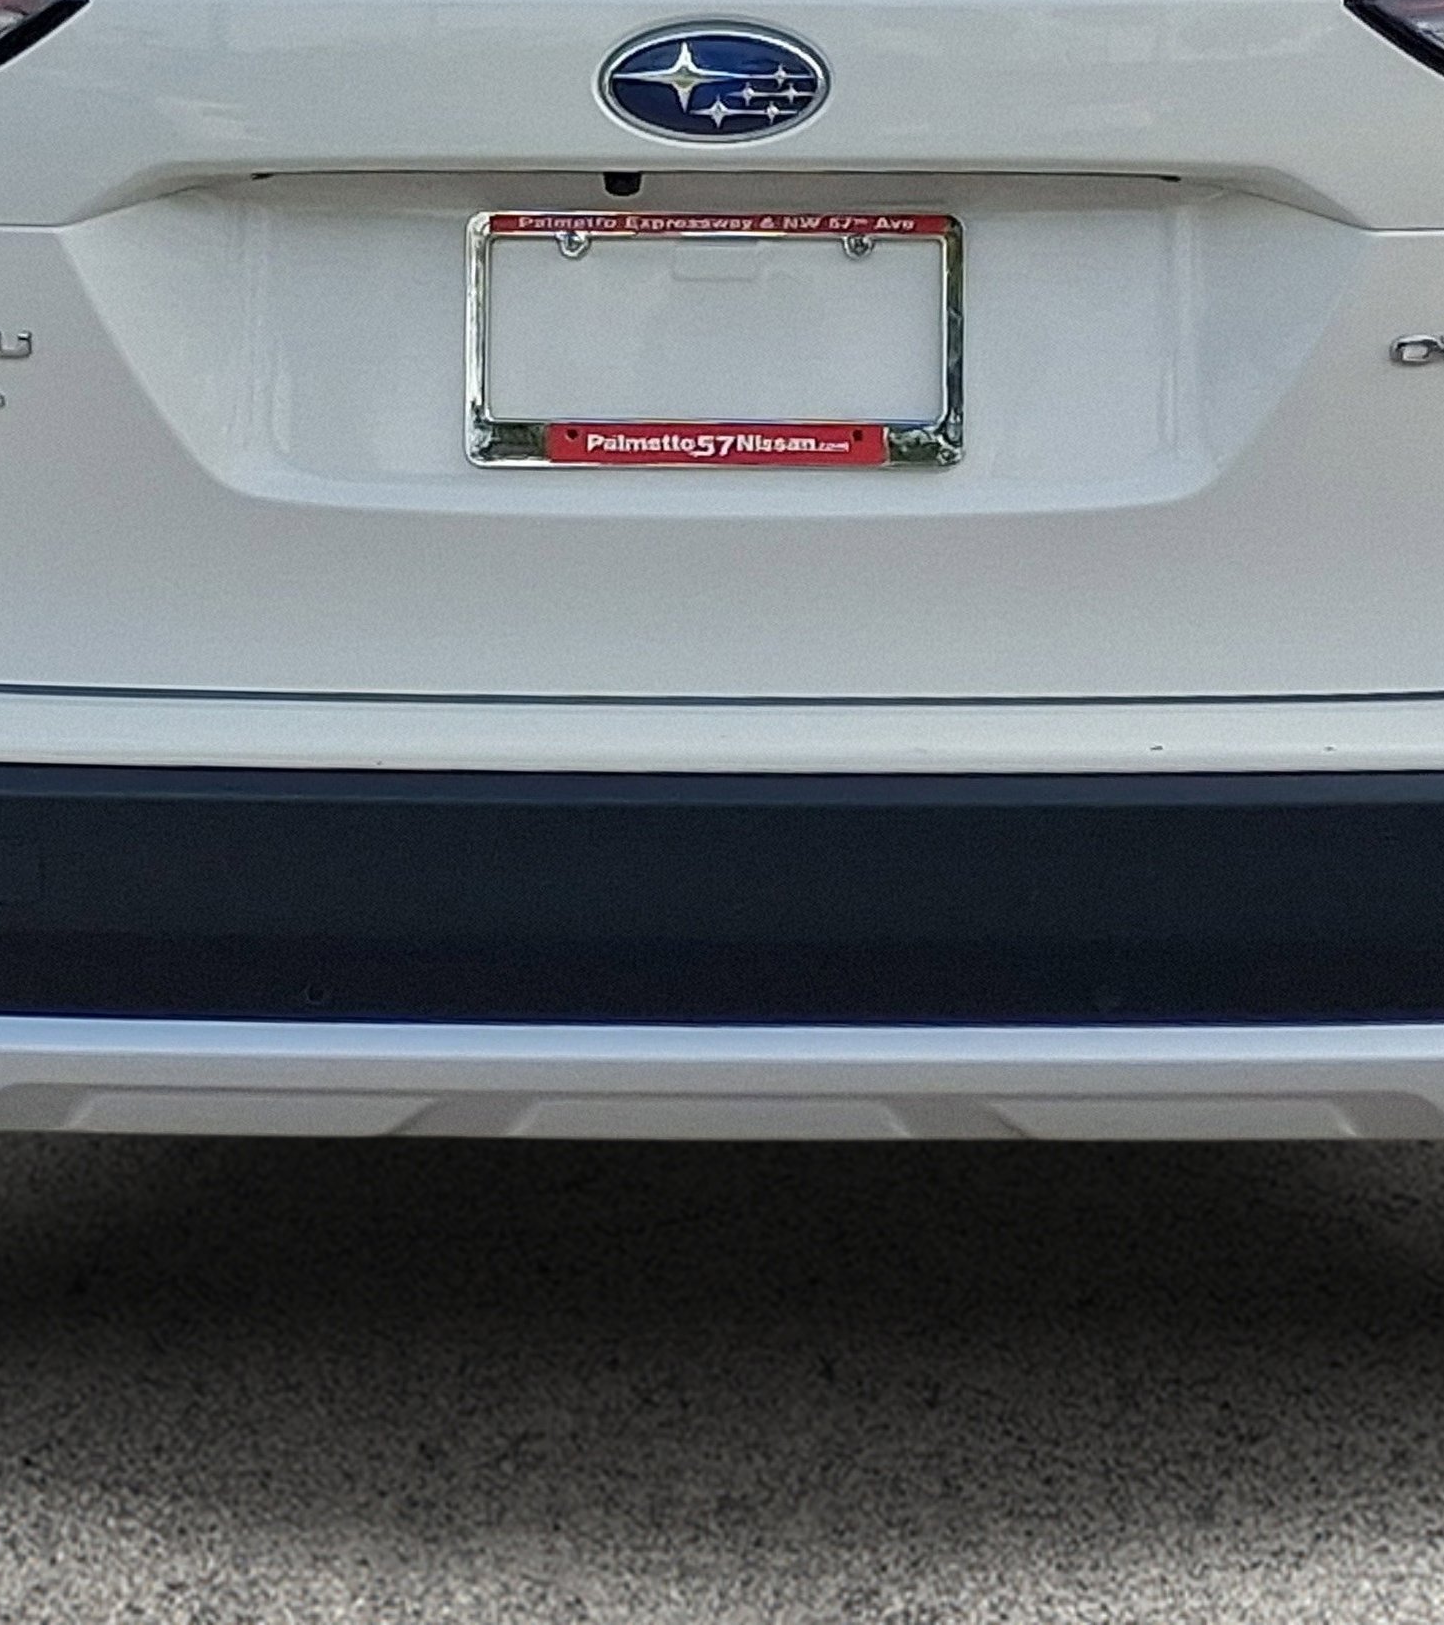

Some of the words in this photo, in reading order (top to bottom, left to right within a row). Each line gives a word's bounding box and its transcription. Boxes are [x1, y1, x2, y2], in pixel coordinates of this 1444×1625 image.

[518, 216, 617, 230] Palmetto
[625, 215, 753, 231] Expressway
[782, 216, 822, 230] NW
[874, 216, 915, 231] Ave
